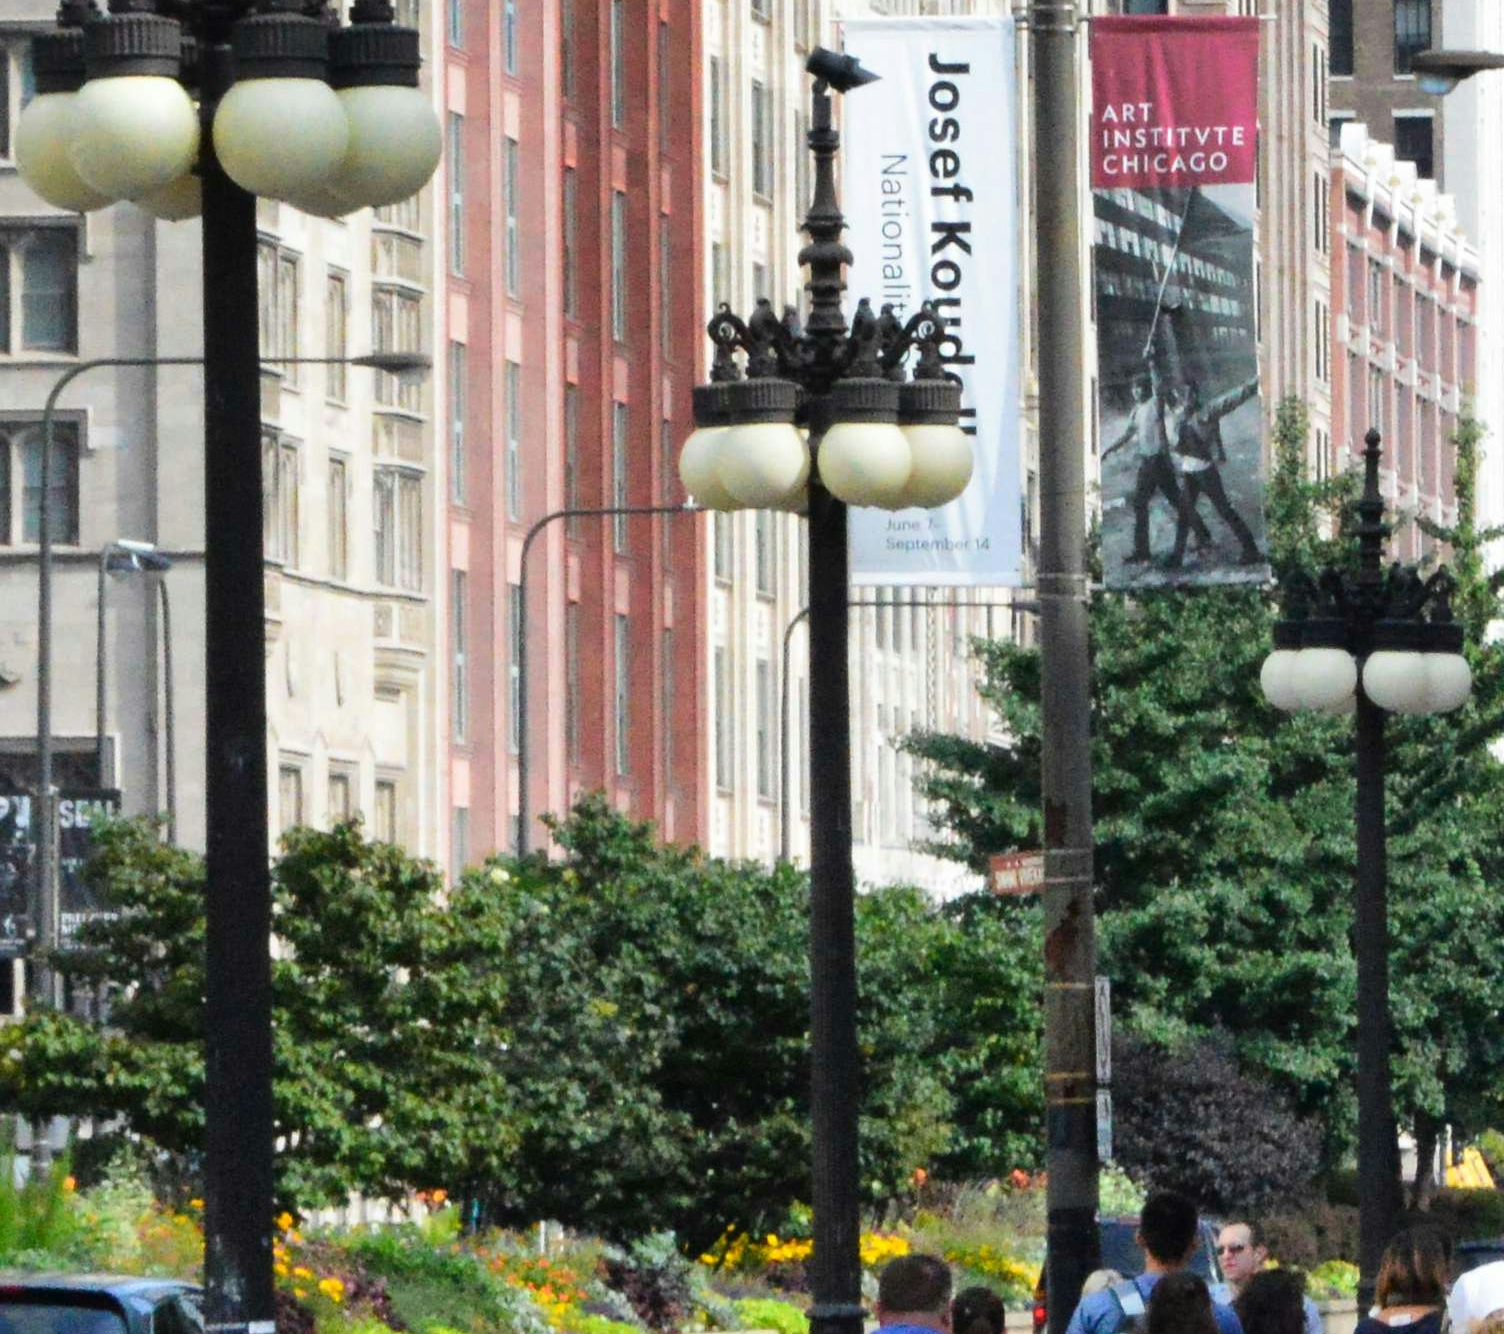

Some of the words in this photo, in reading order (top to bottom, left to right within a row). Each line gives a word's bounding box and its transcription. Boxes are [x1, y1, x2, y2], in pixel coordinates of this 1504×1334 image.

[1102, 102, 1153, 124] ART
[928, 51, 974, 203] Josef
[1102, 126, 1246, 149] INSTITVTE
[1102, 151, 1229, 175] CHICAGO
[886, 516, 921, 532] June
[886, 536, 970, 554] September
[975, 536, 991, 550] 14
